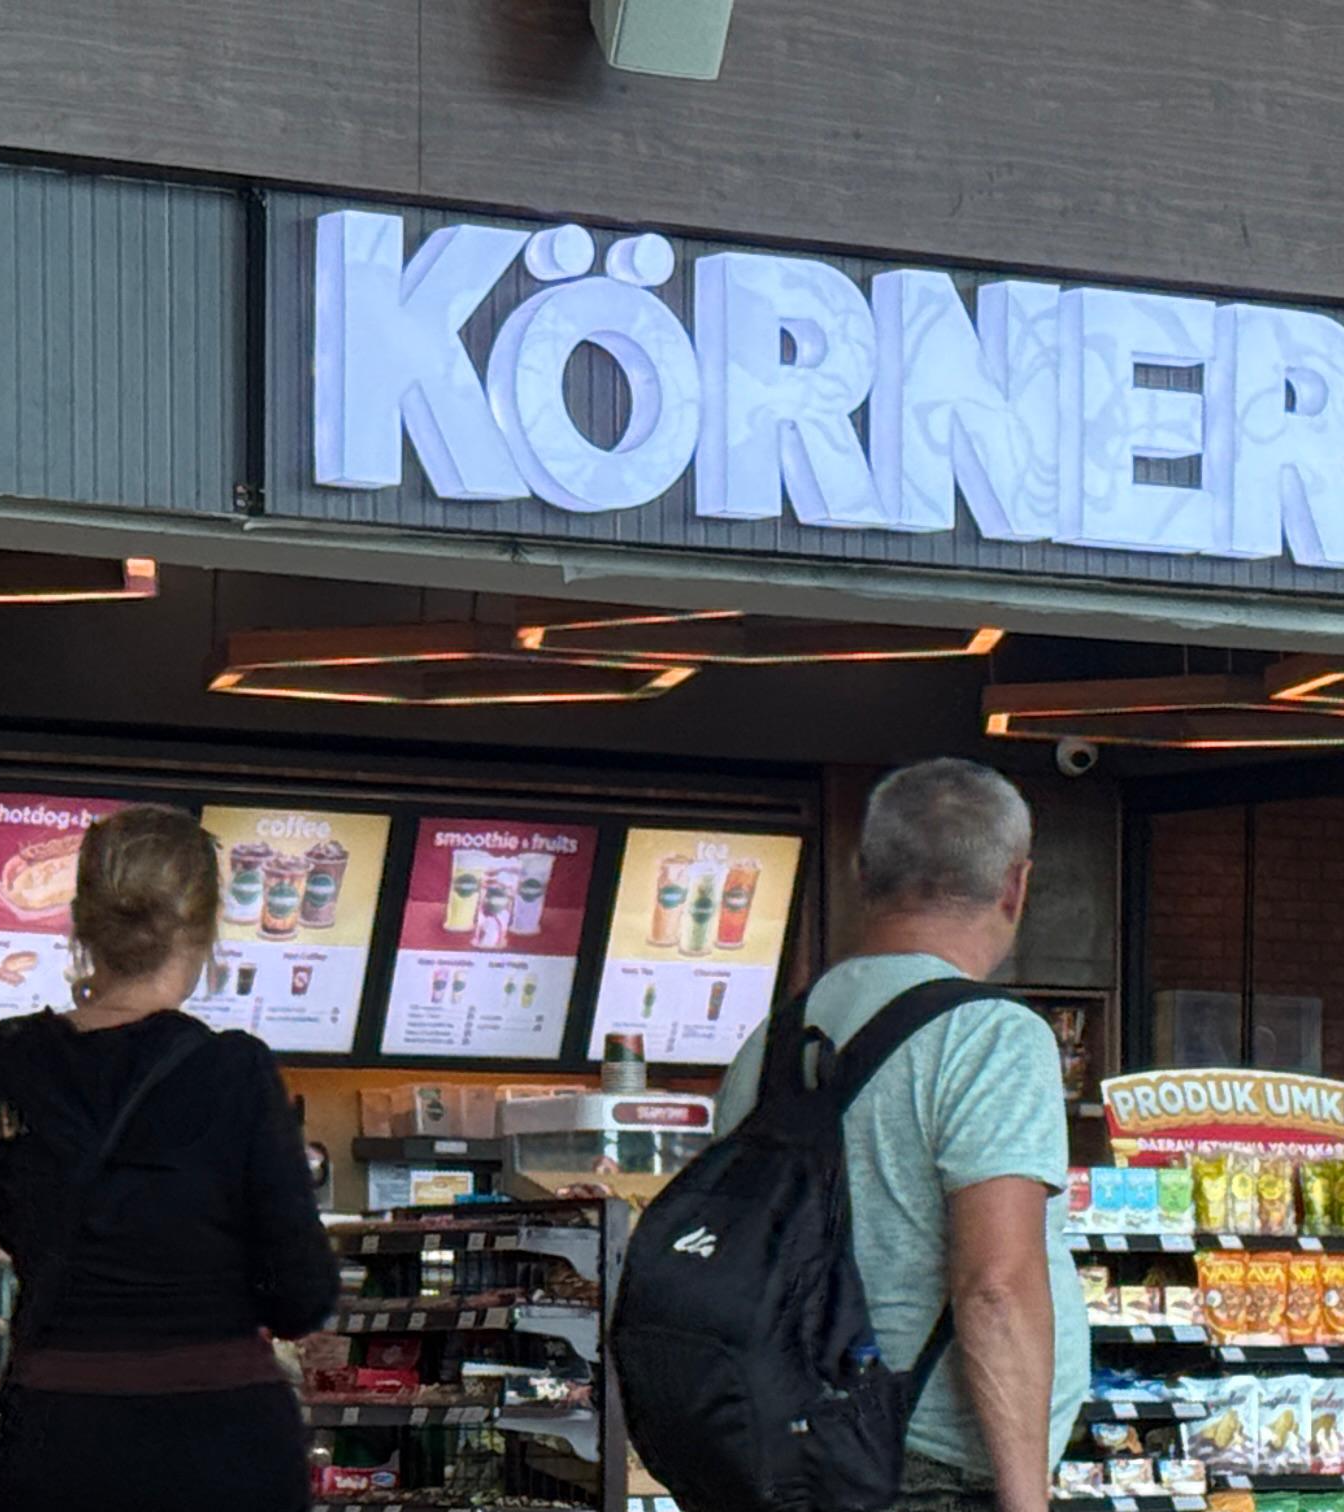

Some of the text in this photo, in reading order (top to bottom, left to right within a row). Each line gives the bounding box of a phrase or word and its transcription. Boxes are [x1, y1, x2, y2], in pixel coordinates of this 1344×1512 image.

[256, 816, 331, 839] coffee
[434, 831, 519, 850] smoothie
[531, 833, 578, 853] fruits
[1112, 1079, 1261, 1122] PRODUK
